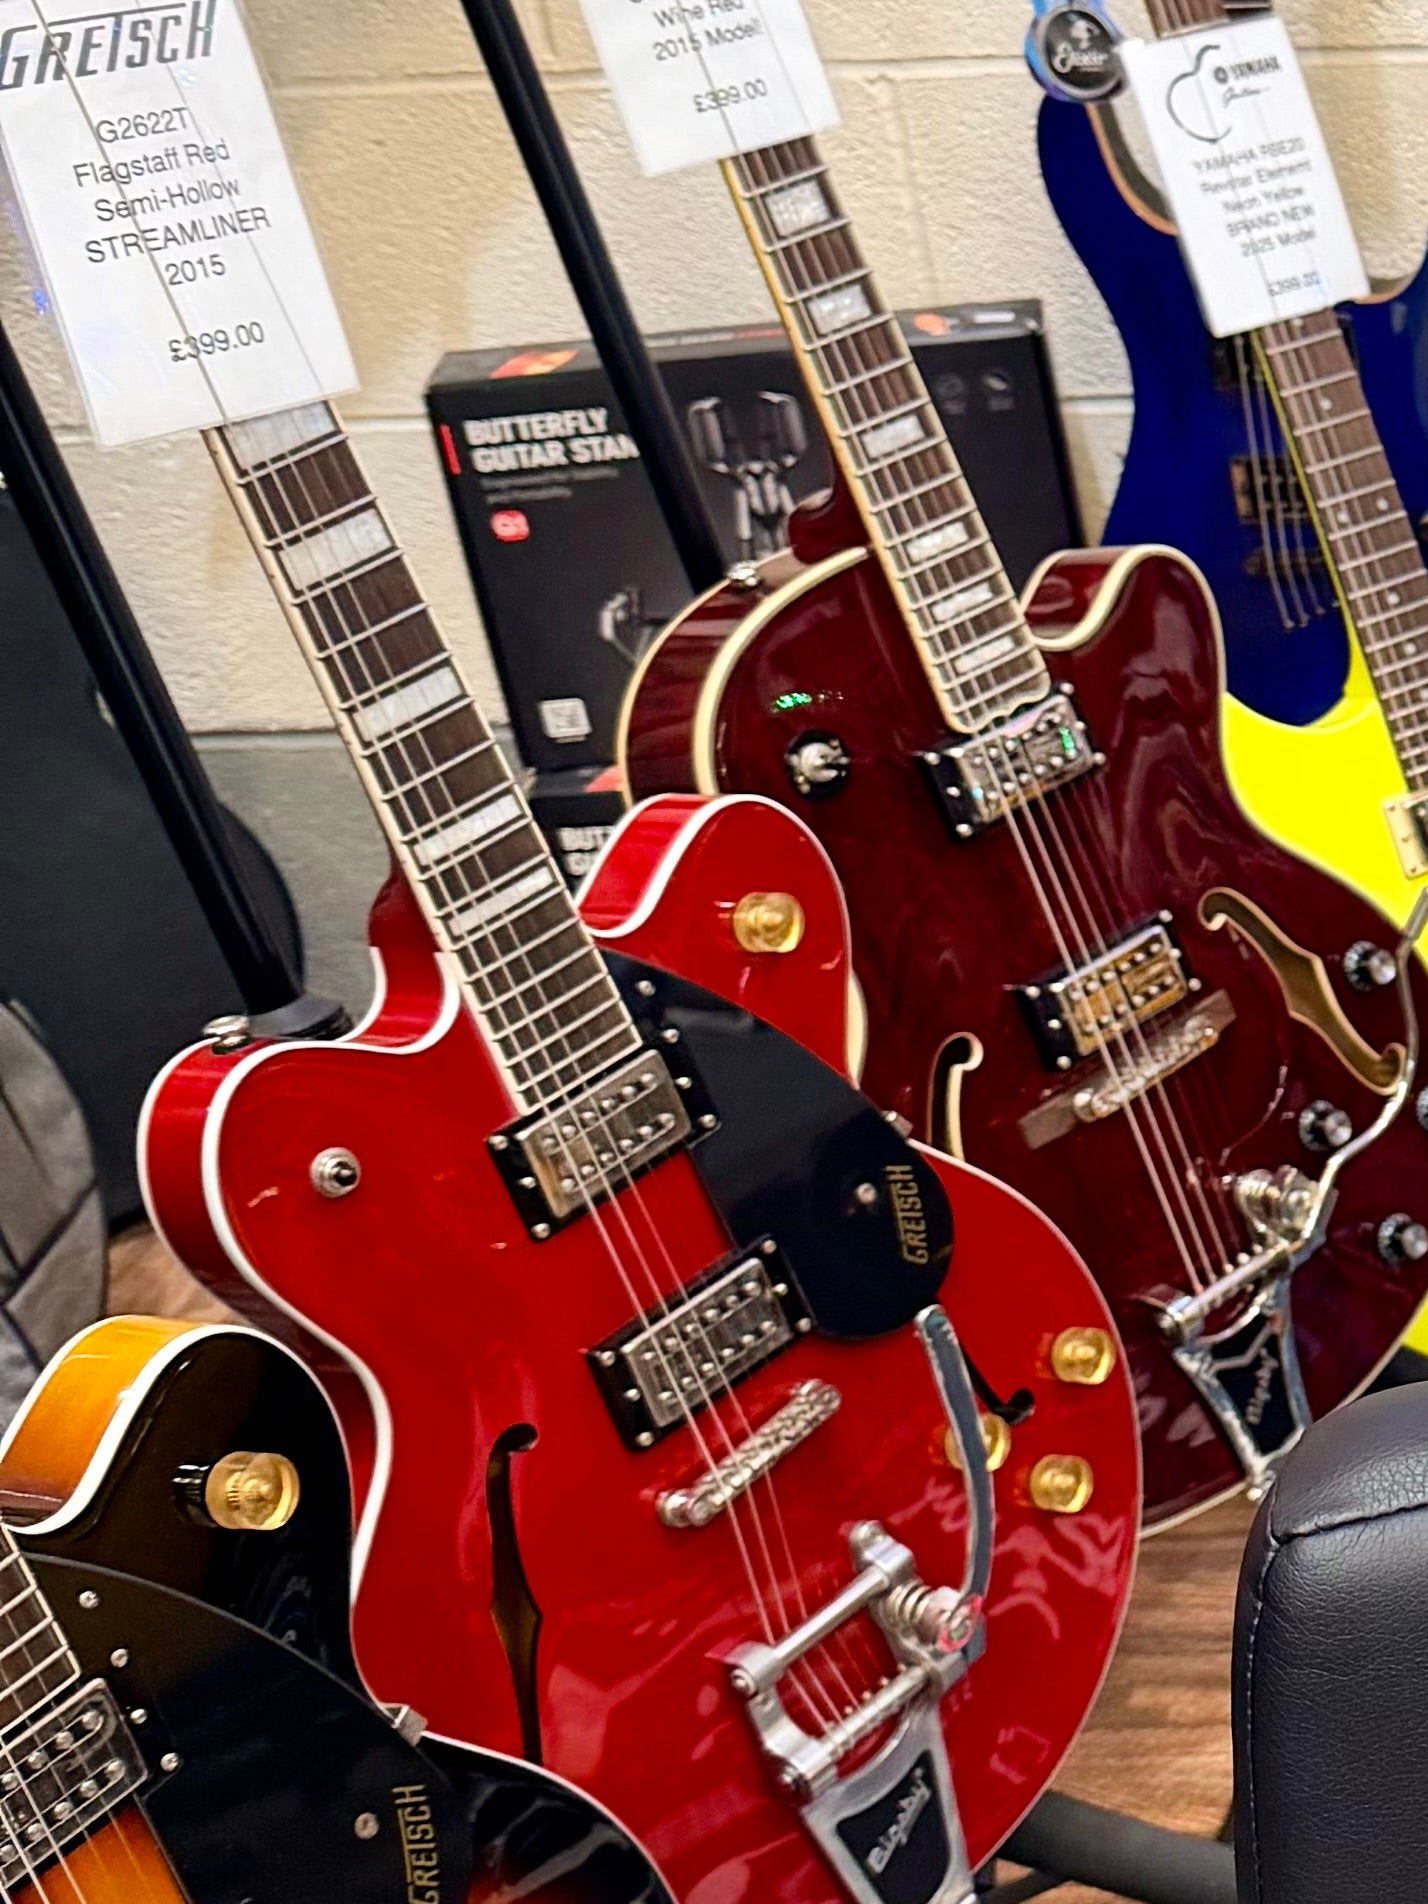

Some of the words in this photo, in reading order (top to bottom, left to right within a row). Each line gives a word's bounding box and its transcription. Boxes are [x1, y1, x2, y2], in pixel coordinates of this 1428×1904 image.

[653, 1, 705, 29] Wine
[0, 0, 217, 90] GRETSCH
[97, 107, 191, 144] G2622T
[73, 148, 180, 187] Flagstaff
[185, 139, 231, 166] Red
[95, 178, 241, 222] Semi-Hollow
[85, 206, 271, 264] STREAMLINER
[166, 254, 225, 286] 2015
[169, 322, 265, 363] £399.00
[462, 407, 608, 446] BUTTERFLY
[471, 440, 569, 473] GUITAR
[569, 433, 640, 464] STAN
[882, 1165, 929, 1265] GRETSCH
